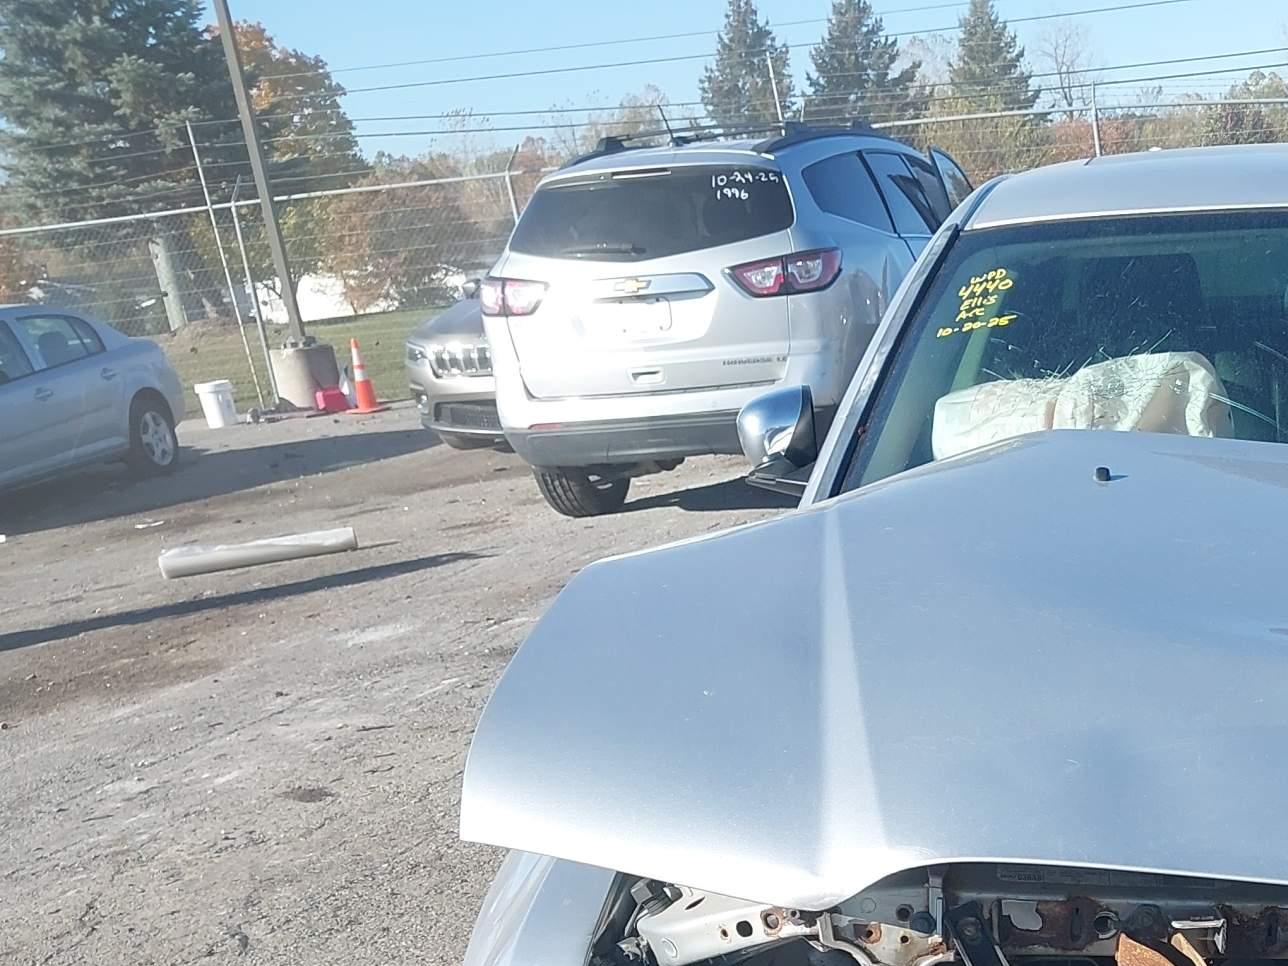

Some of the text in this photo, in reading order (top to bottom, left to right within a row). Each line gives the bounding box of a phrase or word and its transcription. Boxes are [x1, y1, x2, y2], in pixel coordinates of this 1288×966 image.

[711, 171, 779, 188] 10-24-25
[716, 187, 749, 200] 1996
[970, 268, 1007, 284] WPD
[958, 278, 1014, 300] 4440
